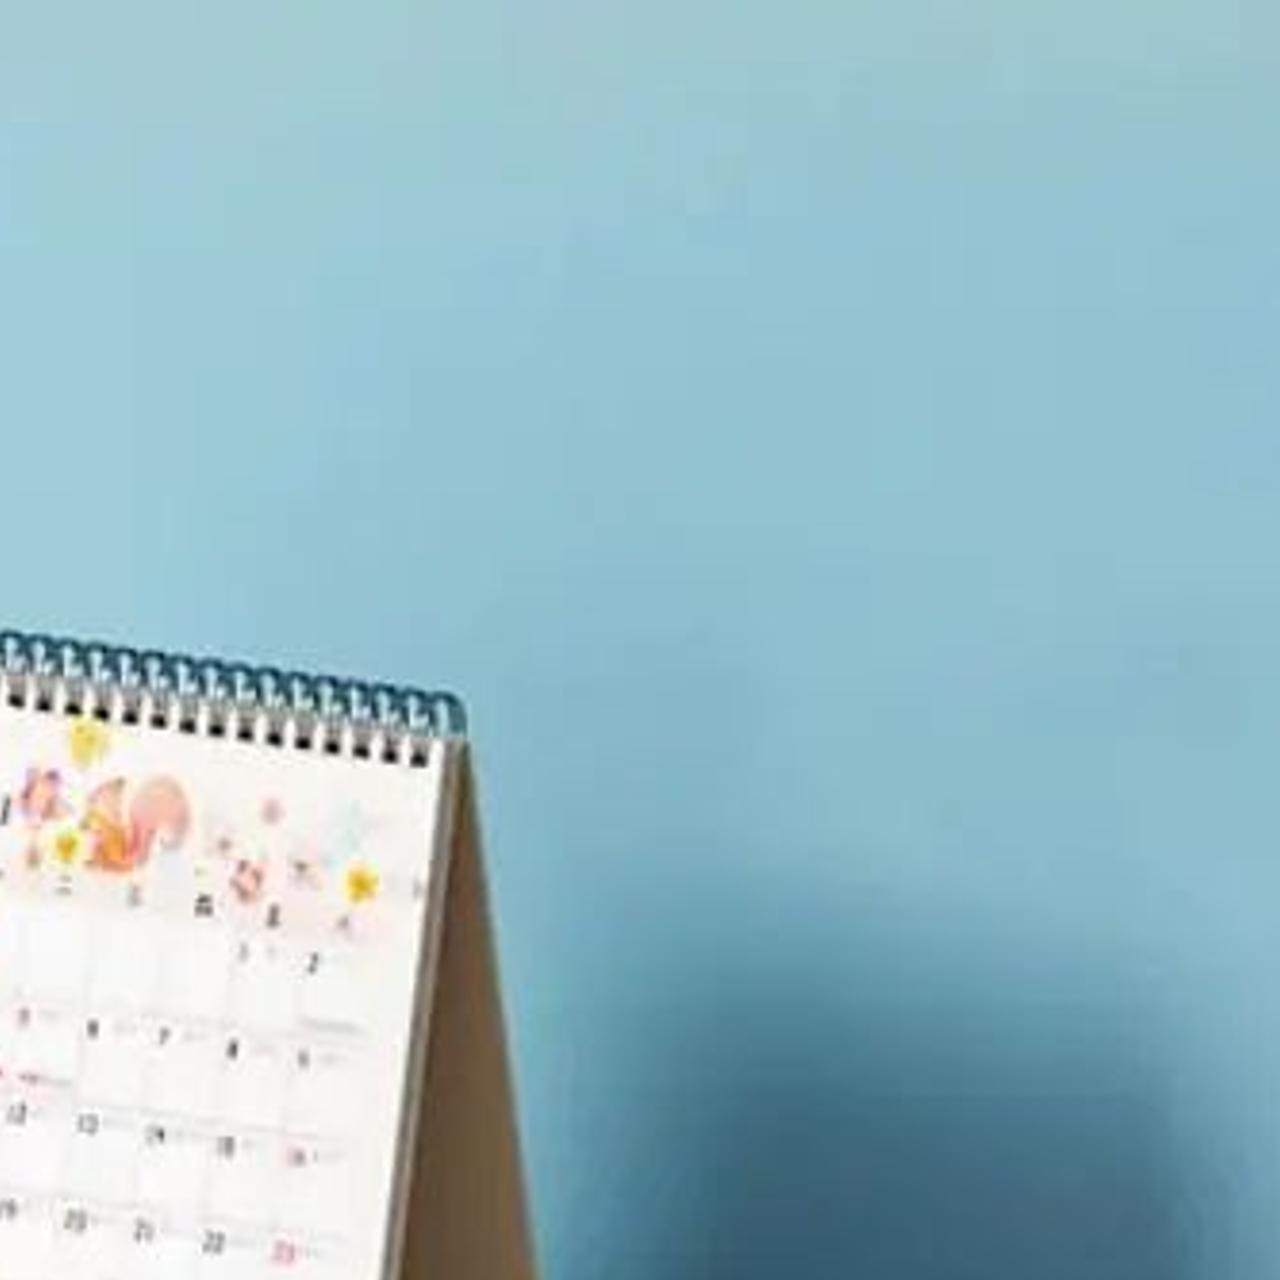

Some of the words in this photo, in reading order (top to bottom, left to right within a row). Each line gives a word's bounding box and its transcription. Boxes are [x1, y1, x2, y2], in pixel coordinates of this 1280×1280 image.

[63, 1206, 88, 1234] 20
[133, 1218, 154, 1243] 21
[202, 1230, 226, 1254] 22
